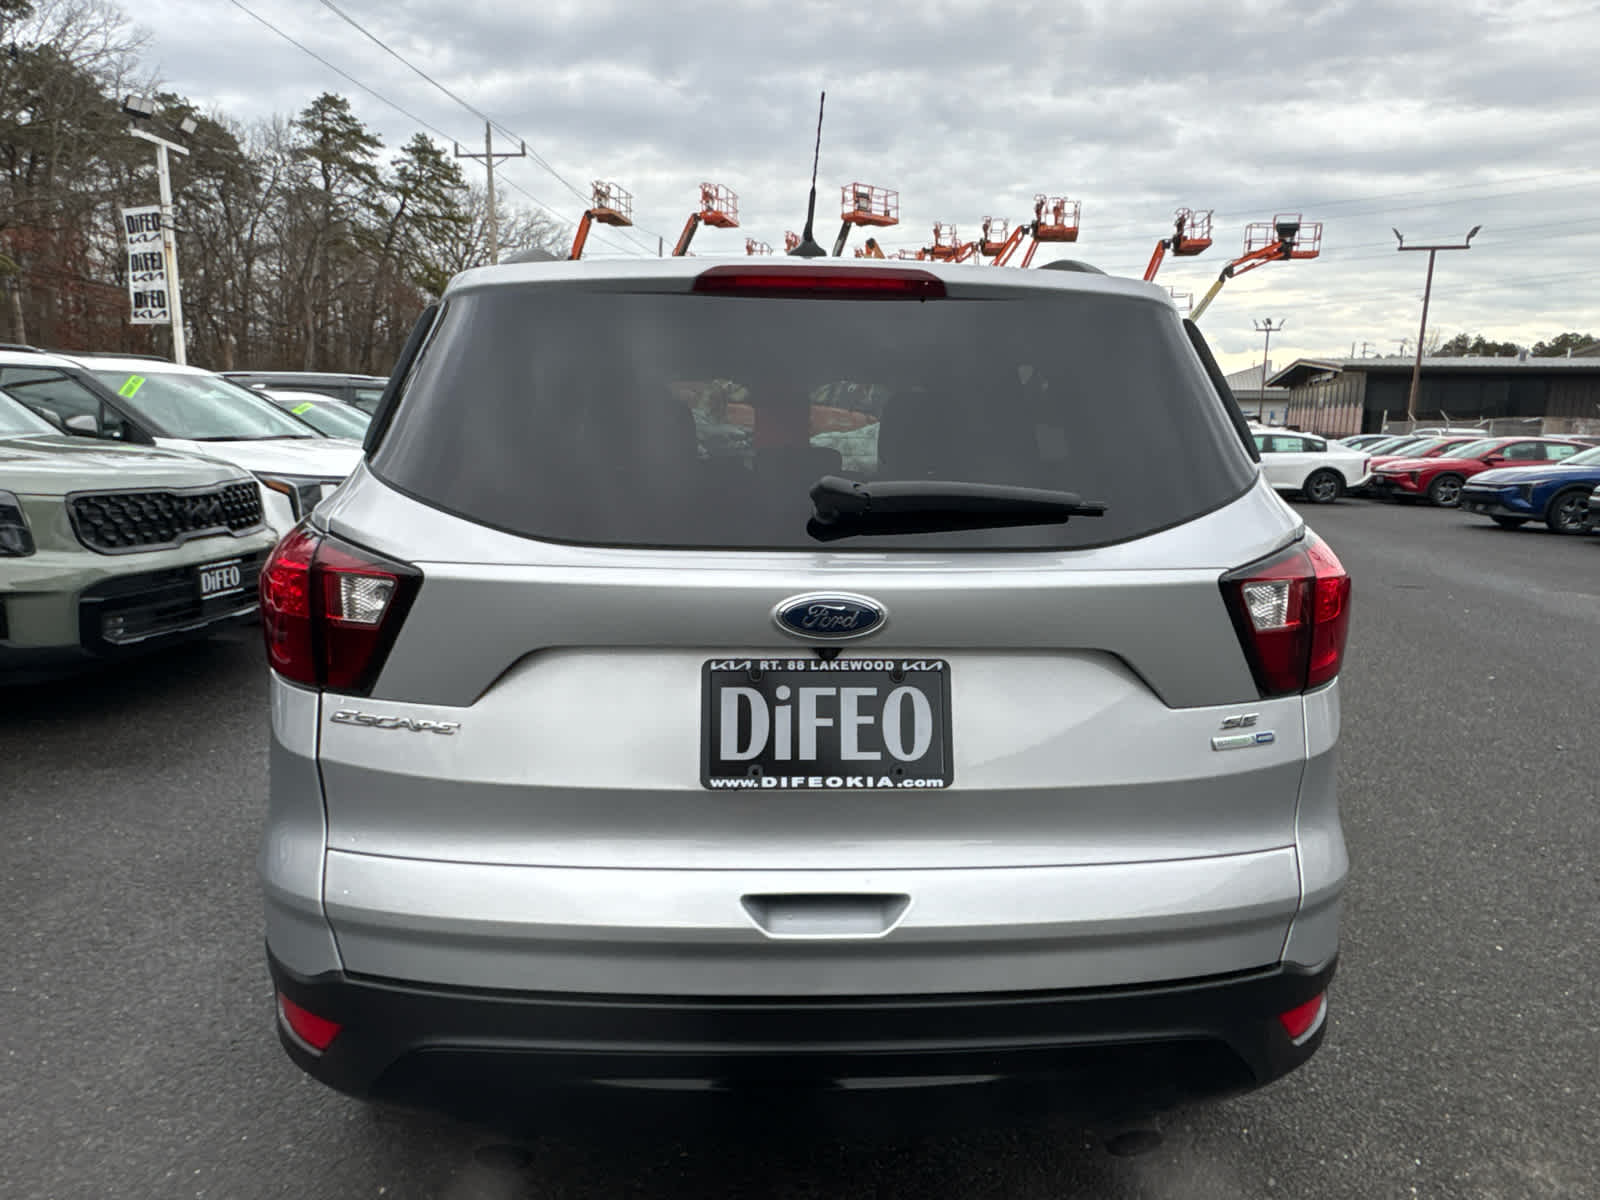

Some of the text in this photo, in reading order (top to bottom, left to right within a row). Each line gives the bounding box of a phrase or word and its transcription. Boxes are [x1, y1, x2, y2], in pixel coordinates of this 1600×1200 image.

[201, 566, 240, 593] DiFEO
[802, 604, 860, 629] Ford
[760, 660, 782, 671] RT.
[787, 660, 805, 671] 88
[810, 660, 895, 671] LAKEWOOD
[330, 709, 461, 735] ESCAPE
[720, 685, 933, 762] DiFEO
[1220, 713, 1259, 730] SE
[710, 776, 944, 788] www.DIFEOKIA.com
